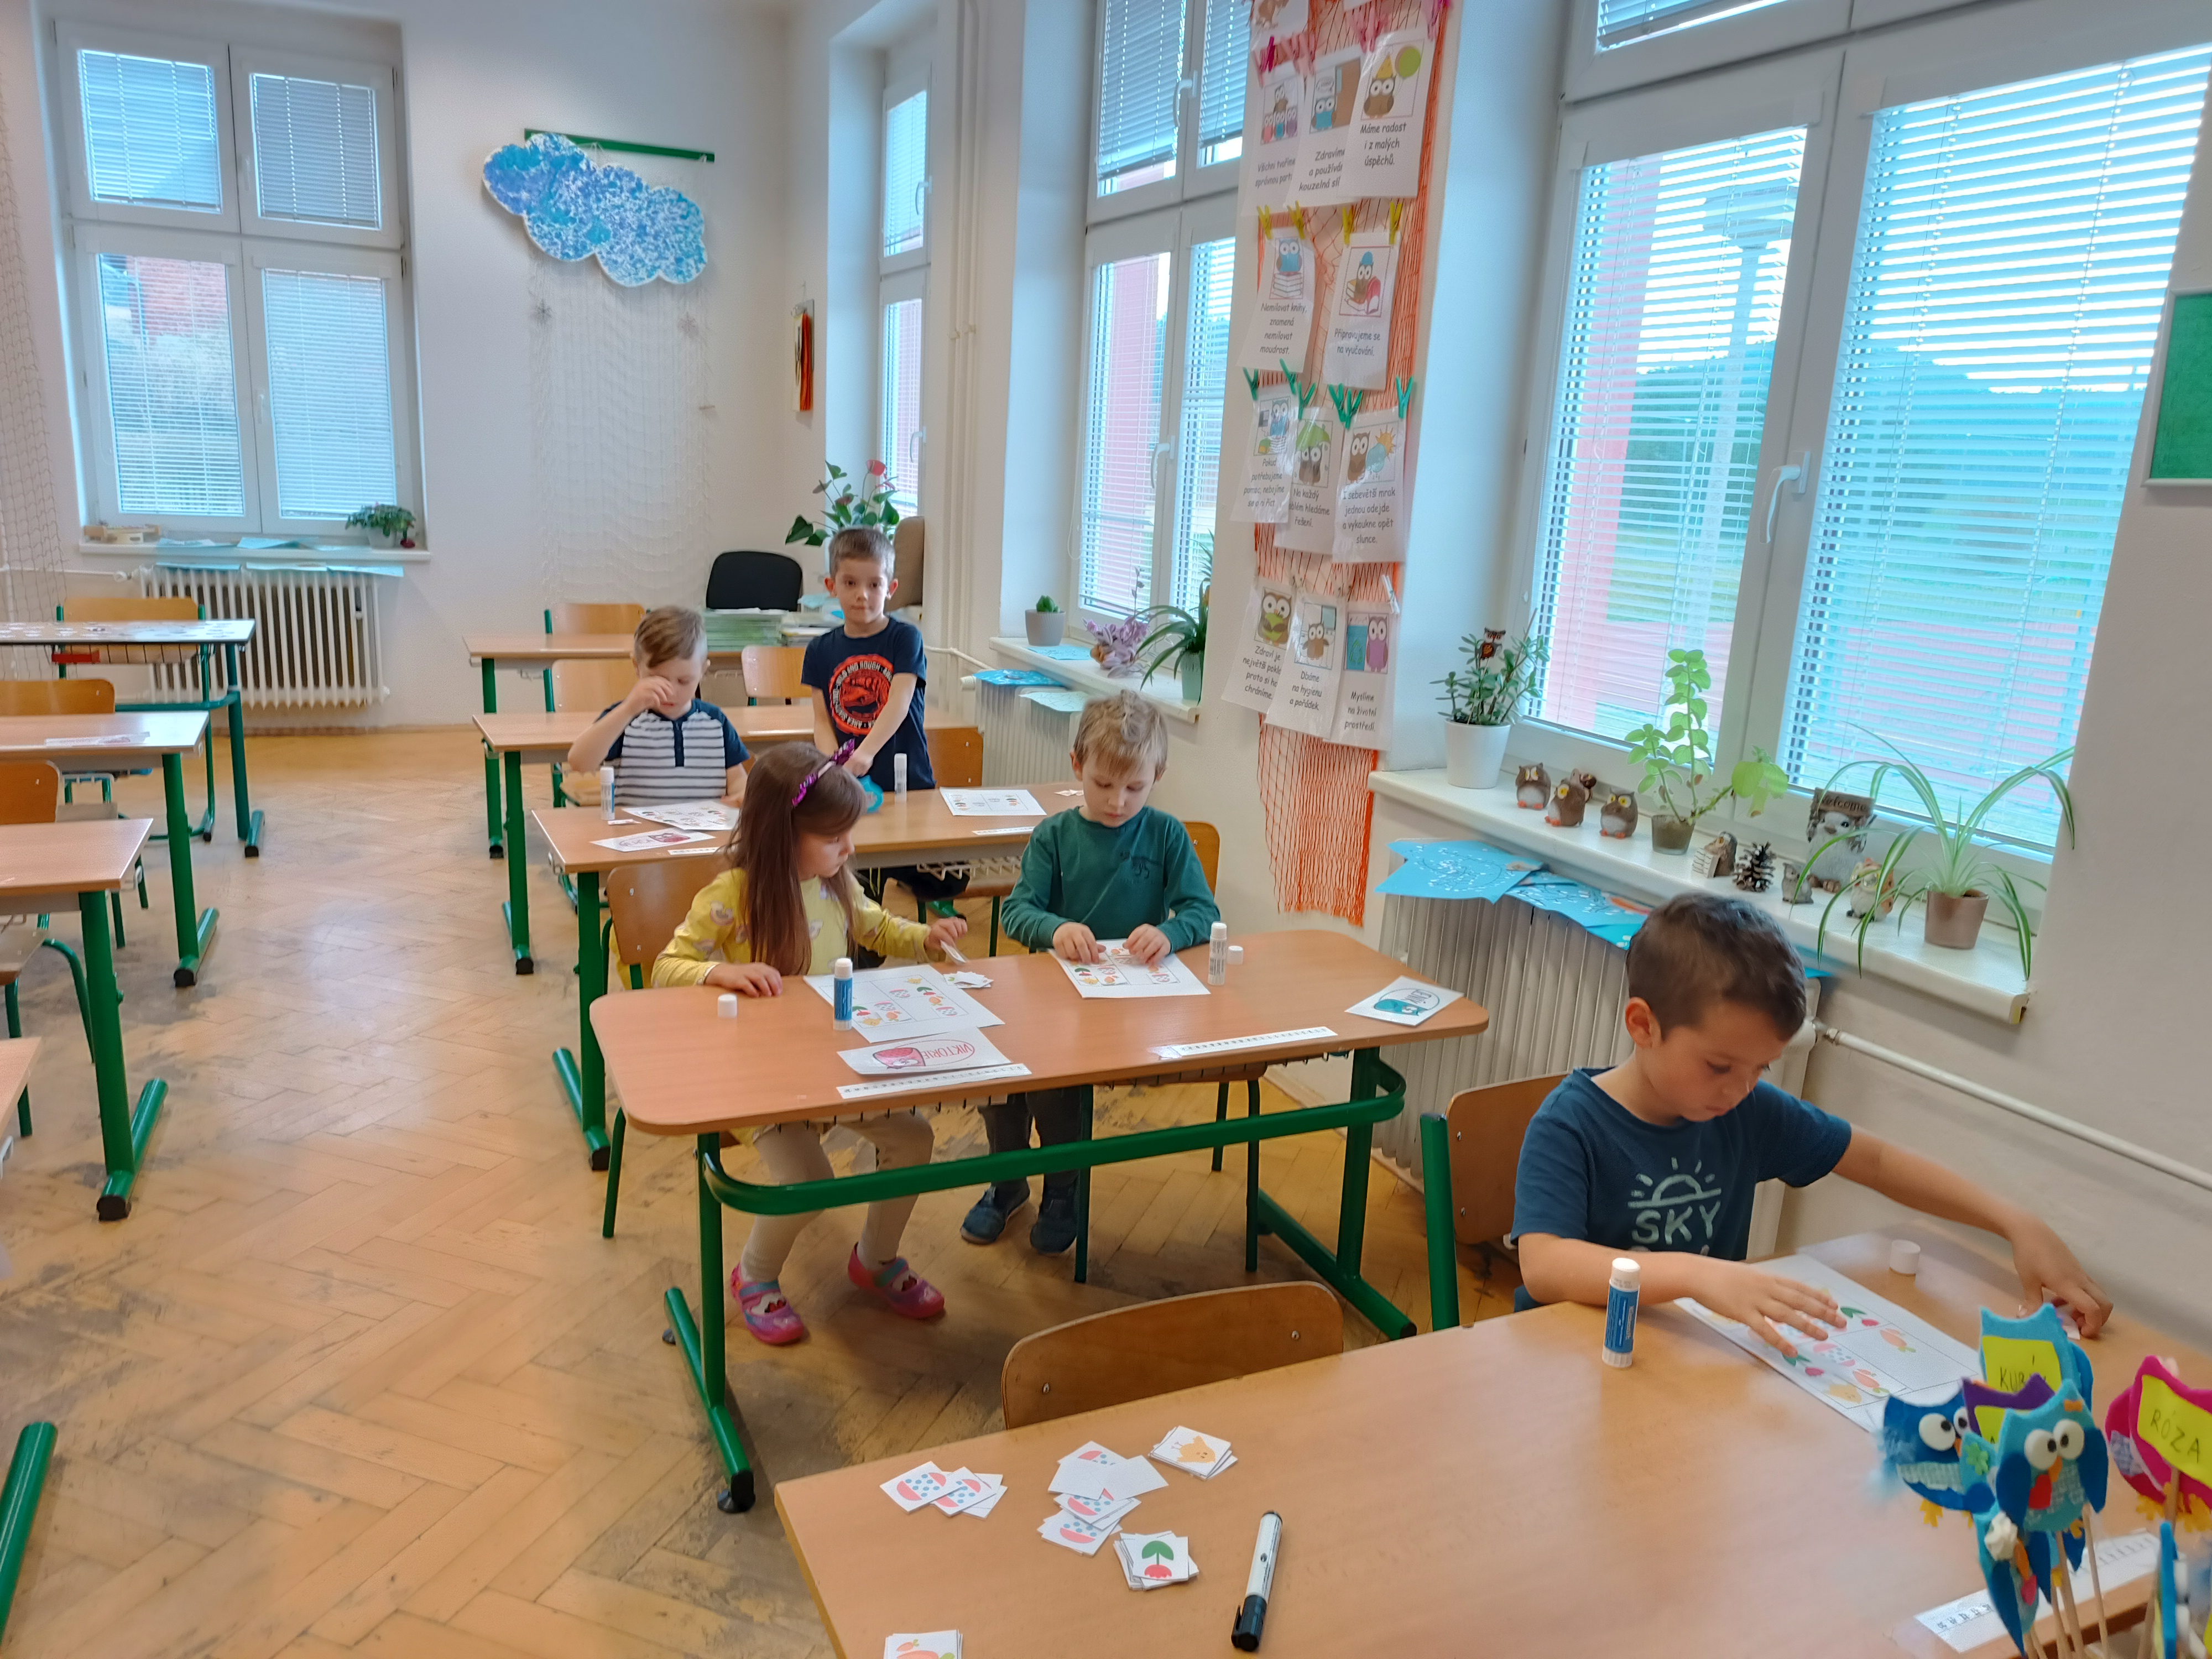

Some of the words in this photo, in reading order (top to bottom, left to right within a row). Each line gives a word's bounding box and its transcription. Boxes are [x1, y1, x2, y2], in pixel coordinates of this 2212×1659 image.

[1360, 123, 1380, 134] Máme
[1381, 122, 1407, 133] radost
[1375, 138, 1400, 152] malých
[1364, 154, 1395, 168] úspěchů.
[1255, 176, 1278, 189] správnou
[1299, 178, 1330, 191] kouzelná
[1261, 302, 1290, 312] Nemilovat
[1269, 317, 1294, 326] znamená
[1264, 331, 1292, 340] nemilovat
[1334, 328, 1372, 341] Připravujeme
[1260, 345, 1290, 354] moudrost.
[1345, 345, 1375, 356] vyučování.
[1262, 458, 1276, 467] Pokud
[1251, 472, 1282, 482] potřebujeme
[1262, 485, 1285, 495] nebojíme
[1293, 488, 1301, 497] Na
[1302, 489, 1319, 502] každý
[1378, 487, 1395, 497] mrak
[1305, 503, 1330, 515] hledáme
[1344, 504, 1365, 517] jednou
[1367, 503, 1390, 517] odejde
[1348, 518, 1376, 531] vykoukne
[1378, 518, 1394, 530] opět
[1356, 535, 1378, 544] slunce.
[1255, 646, 1274, 658] Zdraví
[1274, 652, 1281, 662] je
[1246, 672, 1262, 682] proto
[1264, 676, 1269, 685] si
[1301, 671, 1319, 682] Dbáme
[1244, 684, 1272, 700] chráníme.
[1301, 685, 1322, 697] hygienu
[1351, 691, 1374, 702] Myslíme
[1356, 706, 1376, 717] životní
[922, 1044, 972, 1060] VIKTORIE
[1632, 1201, 1721, 1245] SKY
